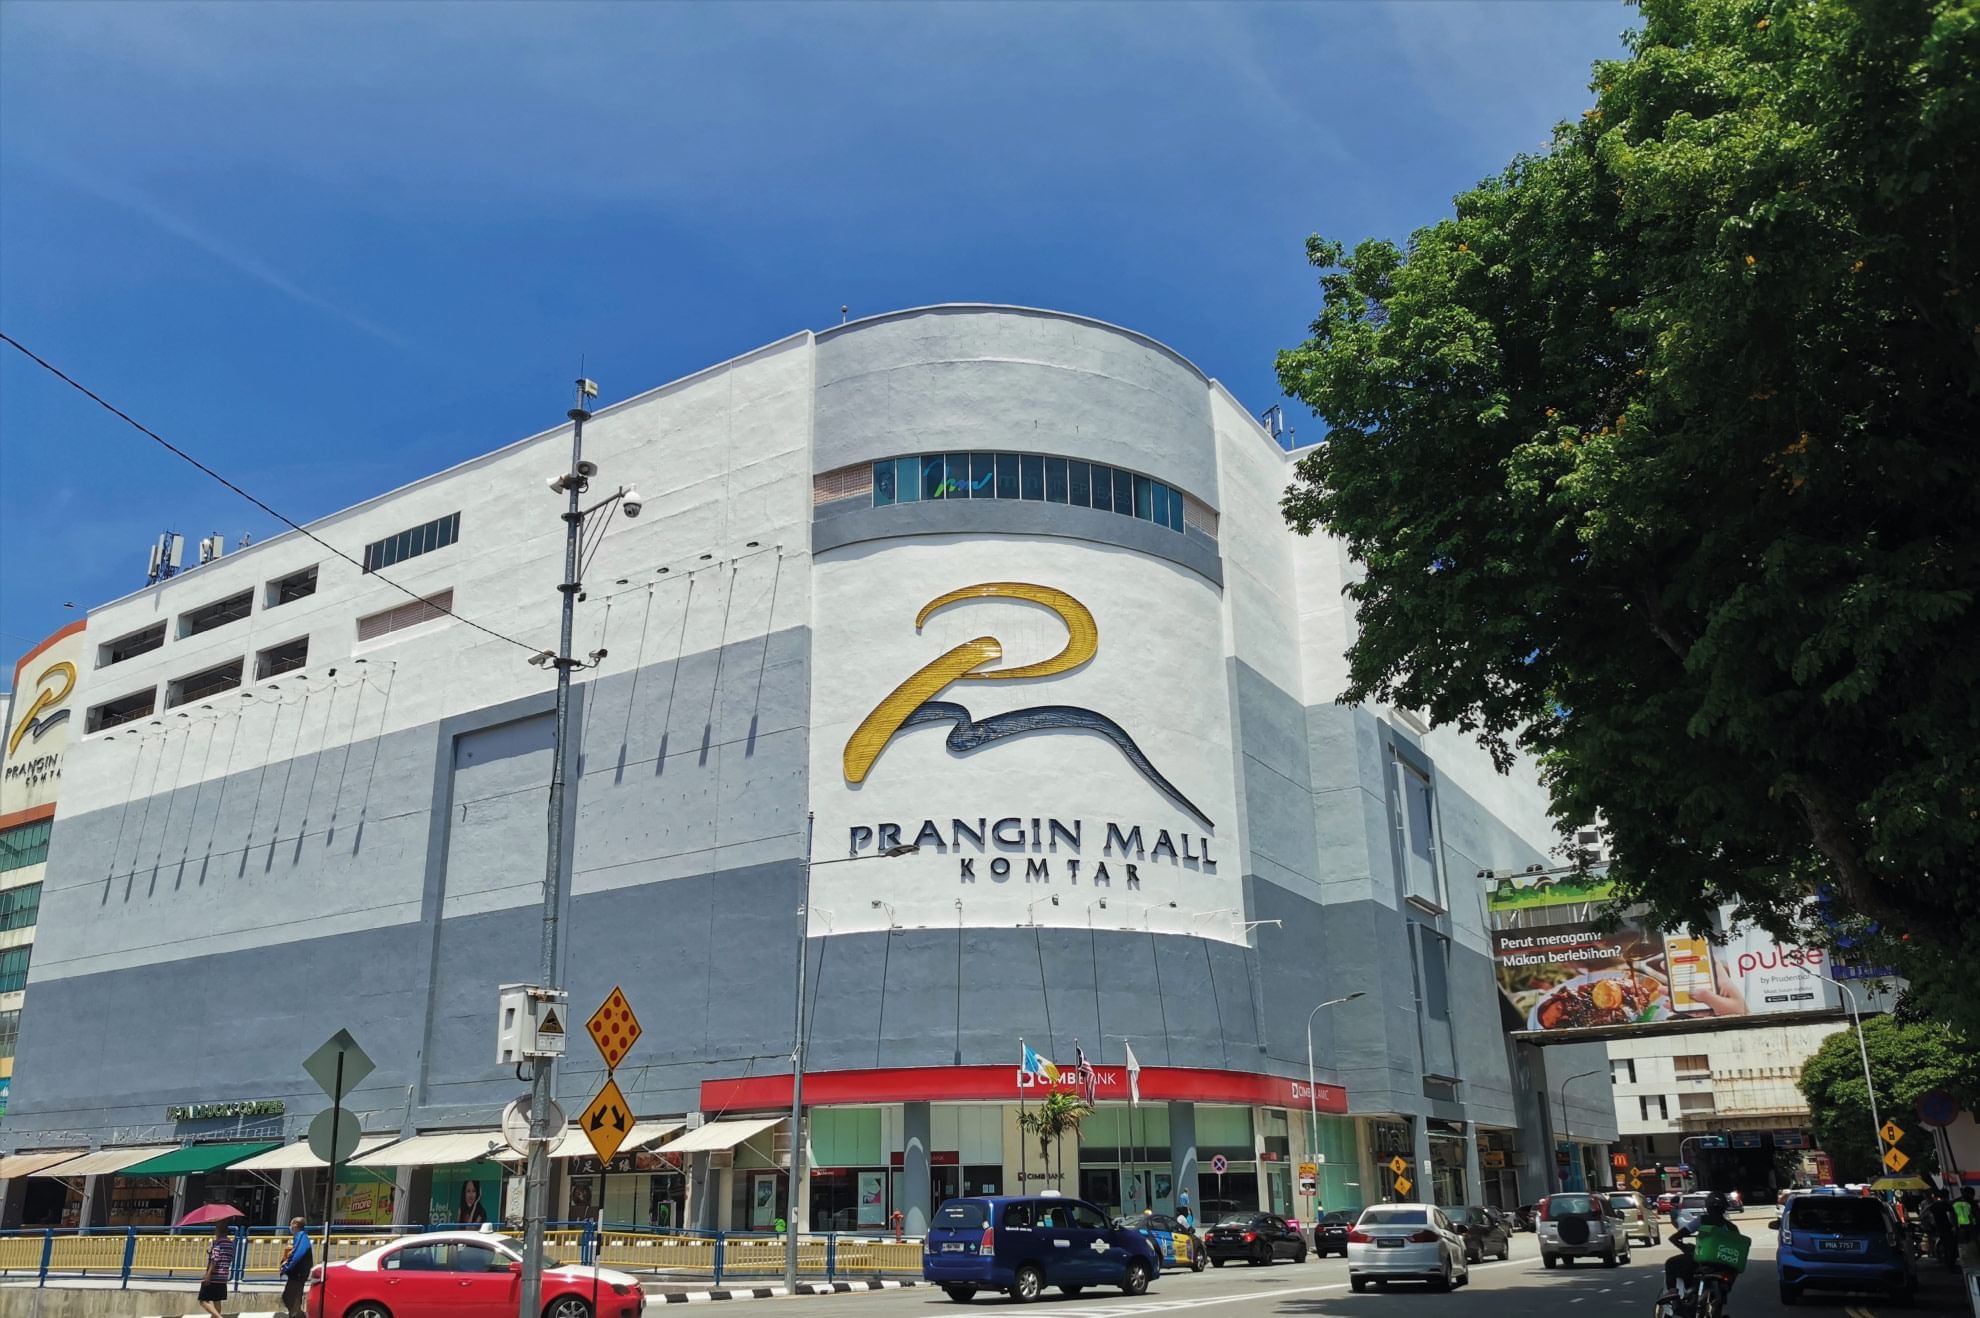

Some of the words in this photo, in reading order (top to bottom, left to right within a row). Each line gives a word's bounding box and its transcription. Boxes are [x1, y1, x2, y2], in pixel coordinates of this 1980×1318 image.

[850, 817, 1081, 854] PRANGIN
[1103, 822, 1218, 866] MALL
[960, 857, 1140, 884] KOMTAR
[1501, 934, 1533, 950] Perut
[1503, 954, 1546, 967] Makan
[1548, 945, 1622, 963] berlebihan?
[1738, 942, 1823, 978] pulse
[167, 1104, 239, 1120] STARBUCKS
[239, 1100, 284, 1116] COFFEE
[352, 1200, 372, 1211] more
[1717, 1252, 1738, 1264] Food
